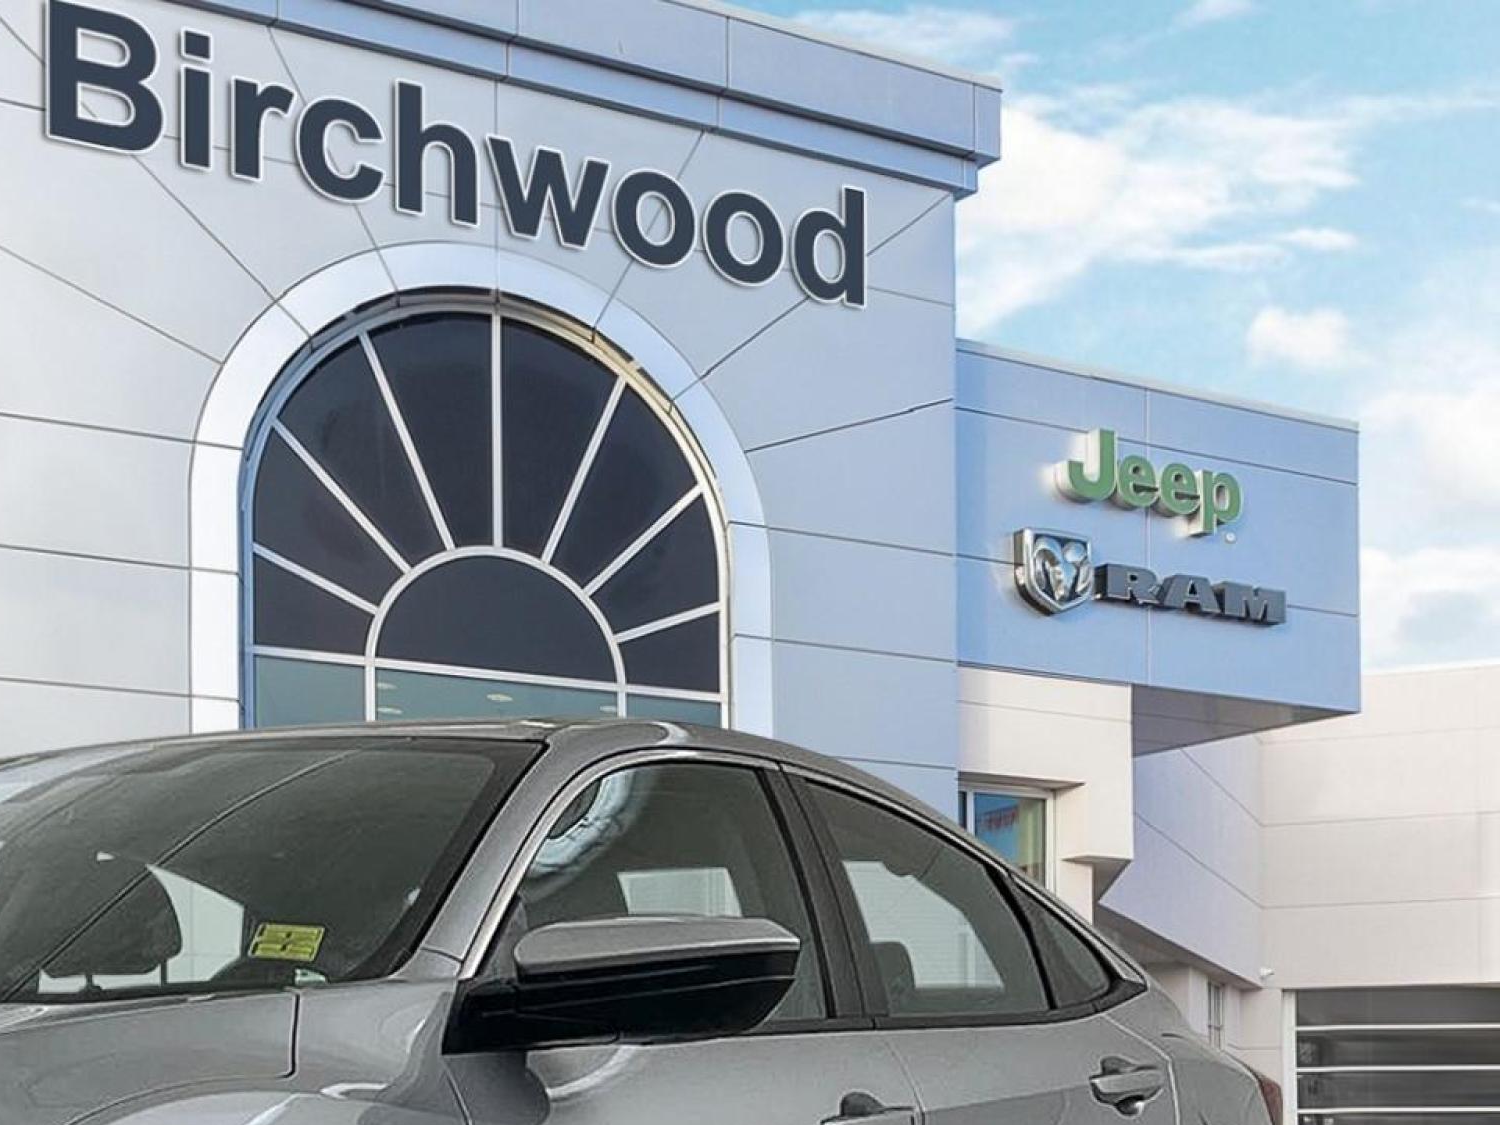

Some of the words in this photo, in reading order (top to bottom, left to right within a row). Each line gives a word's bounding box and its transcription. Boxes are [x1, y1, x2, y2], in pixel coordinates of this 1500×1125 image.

[46, 0, 868, 308] Birchwood
[1056, 428, 1243, 536] Jeep
[1093, 563, 1287, 625] RAM
